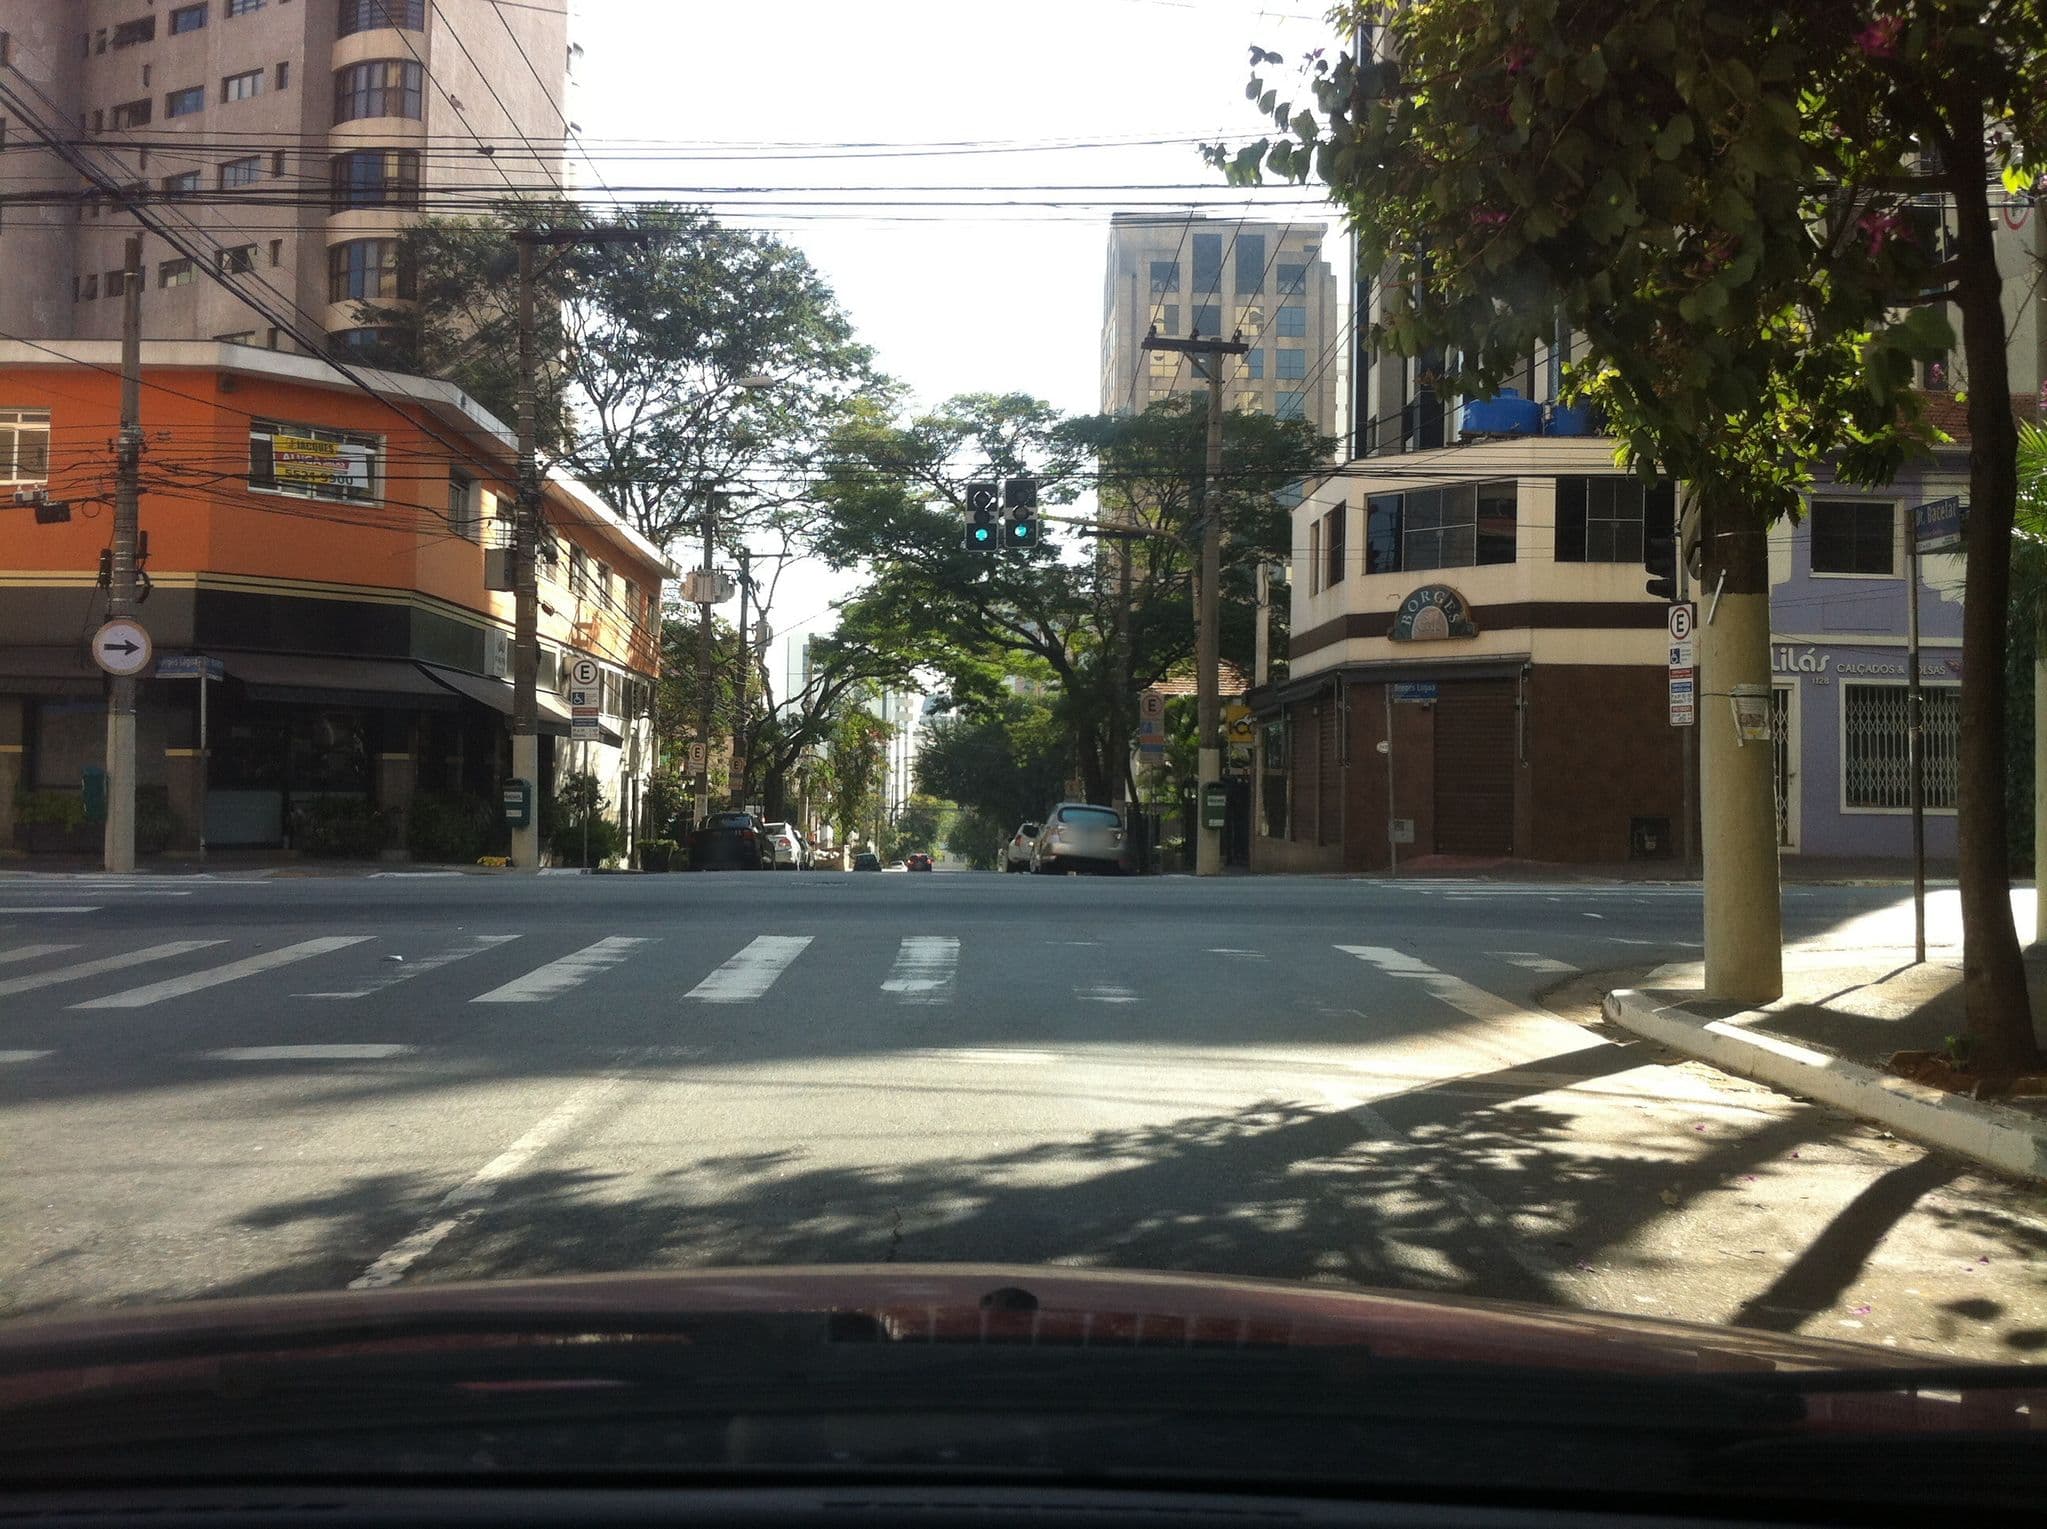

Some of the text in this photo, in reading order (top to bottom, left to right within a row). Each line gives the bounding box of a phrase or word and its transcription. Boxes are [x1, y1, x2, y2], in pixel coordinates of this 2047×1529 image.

[283, 452, 322, 467] ALUGA
[1927, 501, 1957, 523] Bacelar
[1401, 590, 1459, 626] BORGES
[1676, 613, 1685, 633] E
[580, 665, 590, 680] E
[1836, 663, 1895, 676] CALÇADOS
[1148, 699, 1157, 712] E
[694, 747, 701, 758] E
